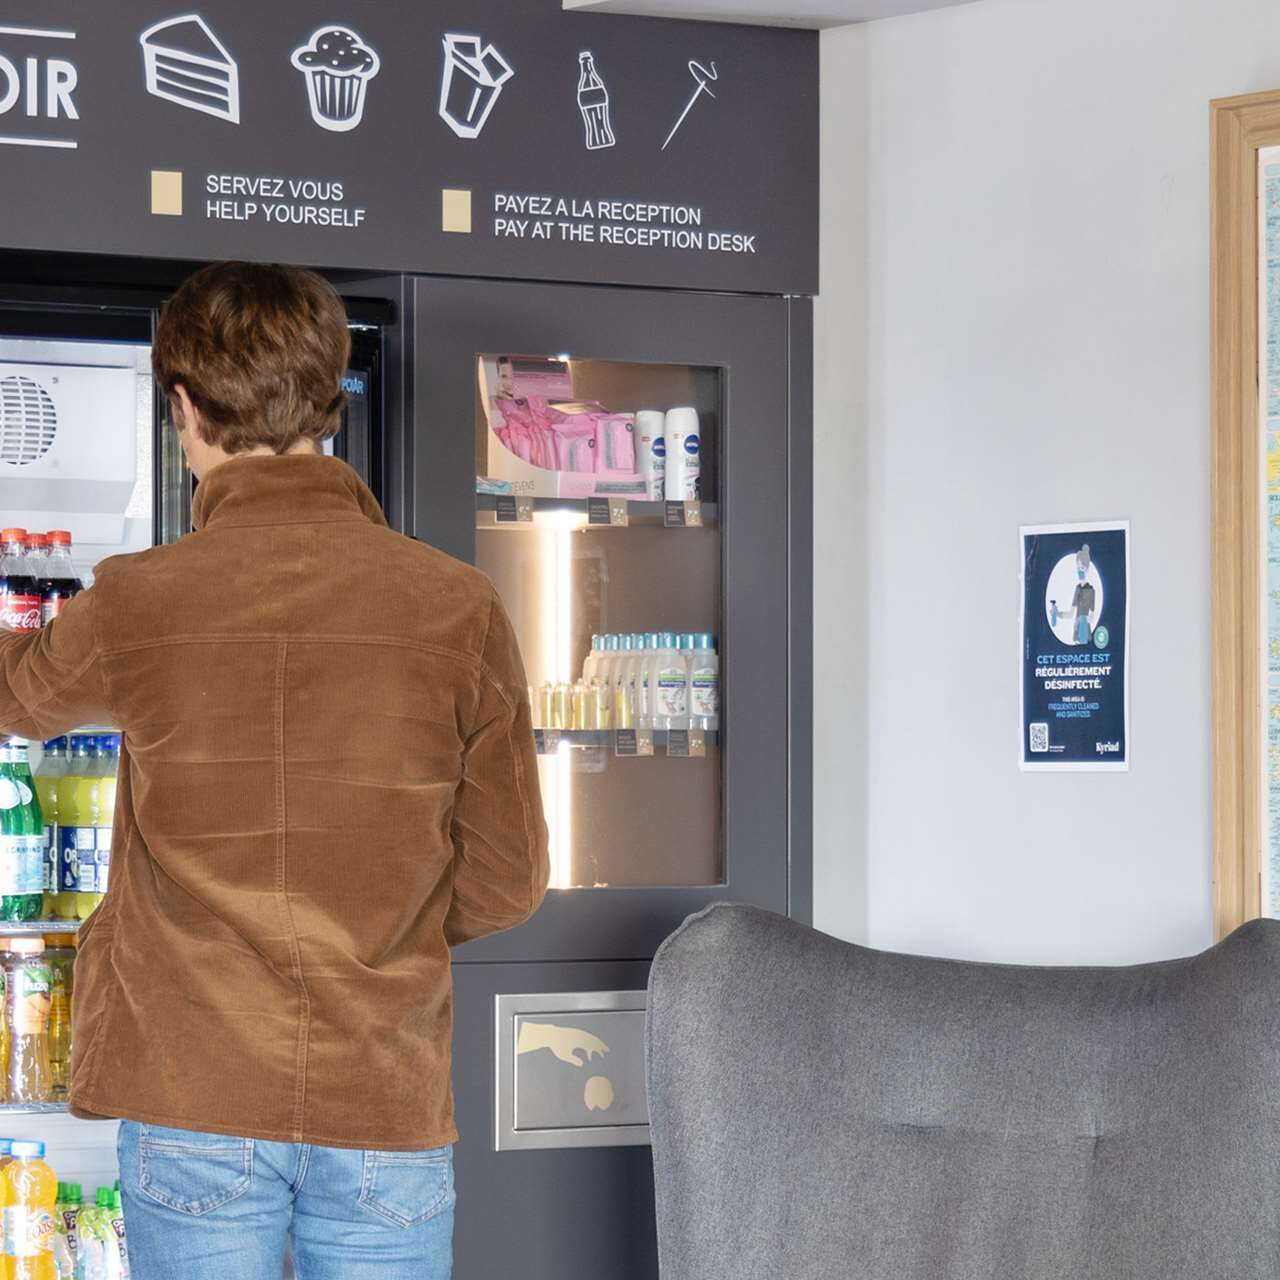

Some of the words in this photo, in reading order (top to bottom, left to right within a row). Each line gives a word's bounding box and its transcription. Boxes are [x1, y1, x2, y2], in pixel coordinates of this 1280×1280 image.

[207, 175, 284, 198] SERVEZ
[289, 179, 343, 201] VOUS
[207, 200, 257, 221] HELP
[261, 202, 365, 227] YOURSELF
[495, 195, 552, 216] PAYEZ
[556, 198, 568, 215] A
[572, 199, 593, 217] LA
[599, 201, 701, 225] RECEPTION
[495, 219, 527, 238] PAY
[532, 221, 553, 239] AT
[558, 222, 595, 242] THE
[600, 225, 703, 251] RECEPTION
[708, 232, 756, 253] DESK
[1036, 655, 1054, 664] CET
[1056, 655, 1090, 664] ESPACE
[1092, 653, 1111, 664] EST
[1096, 742, 1120, 755] Kyriad
